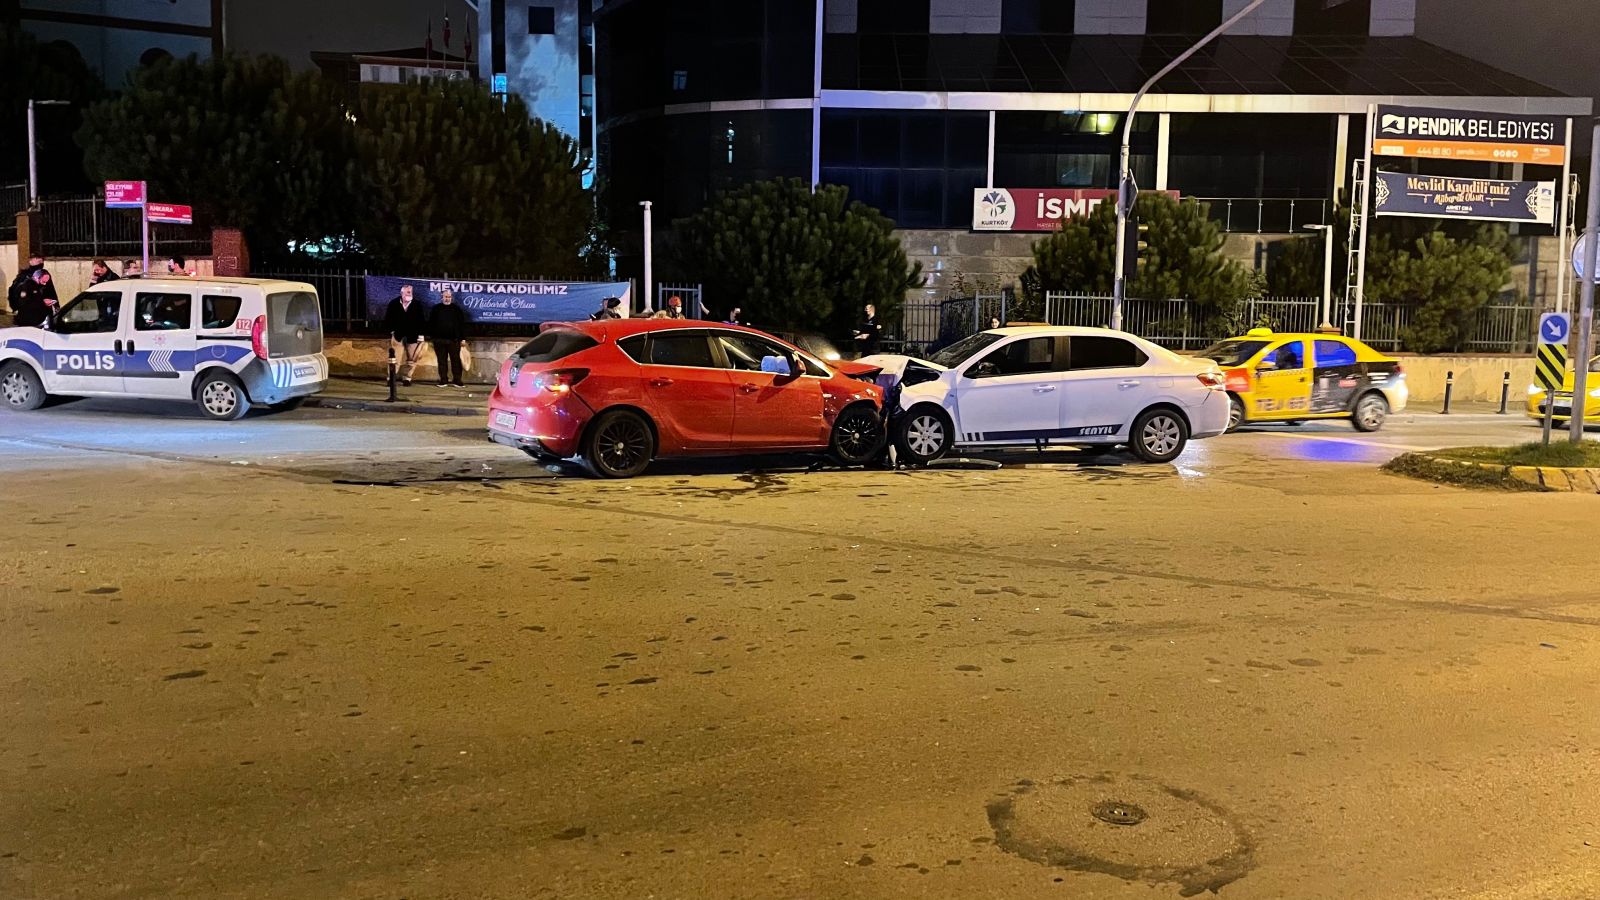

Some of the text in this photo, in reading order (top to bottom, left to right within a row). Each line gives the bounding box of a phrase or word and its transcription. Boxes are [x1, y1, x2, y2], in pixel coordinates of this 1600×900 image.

[1407, 116, 1555, 141] PENDİK BELEDİYESİ
[1407, 177, 1445, 191] Mevlid
[430, 281, 569, 295] MEVLİD KANDİLİMİZ
[237, 319, 250, 330] 112
[56, 352, 115, 370] POLİS
